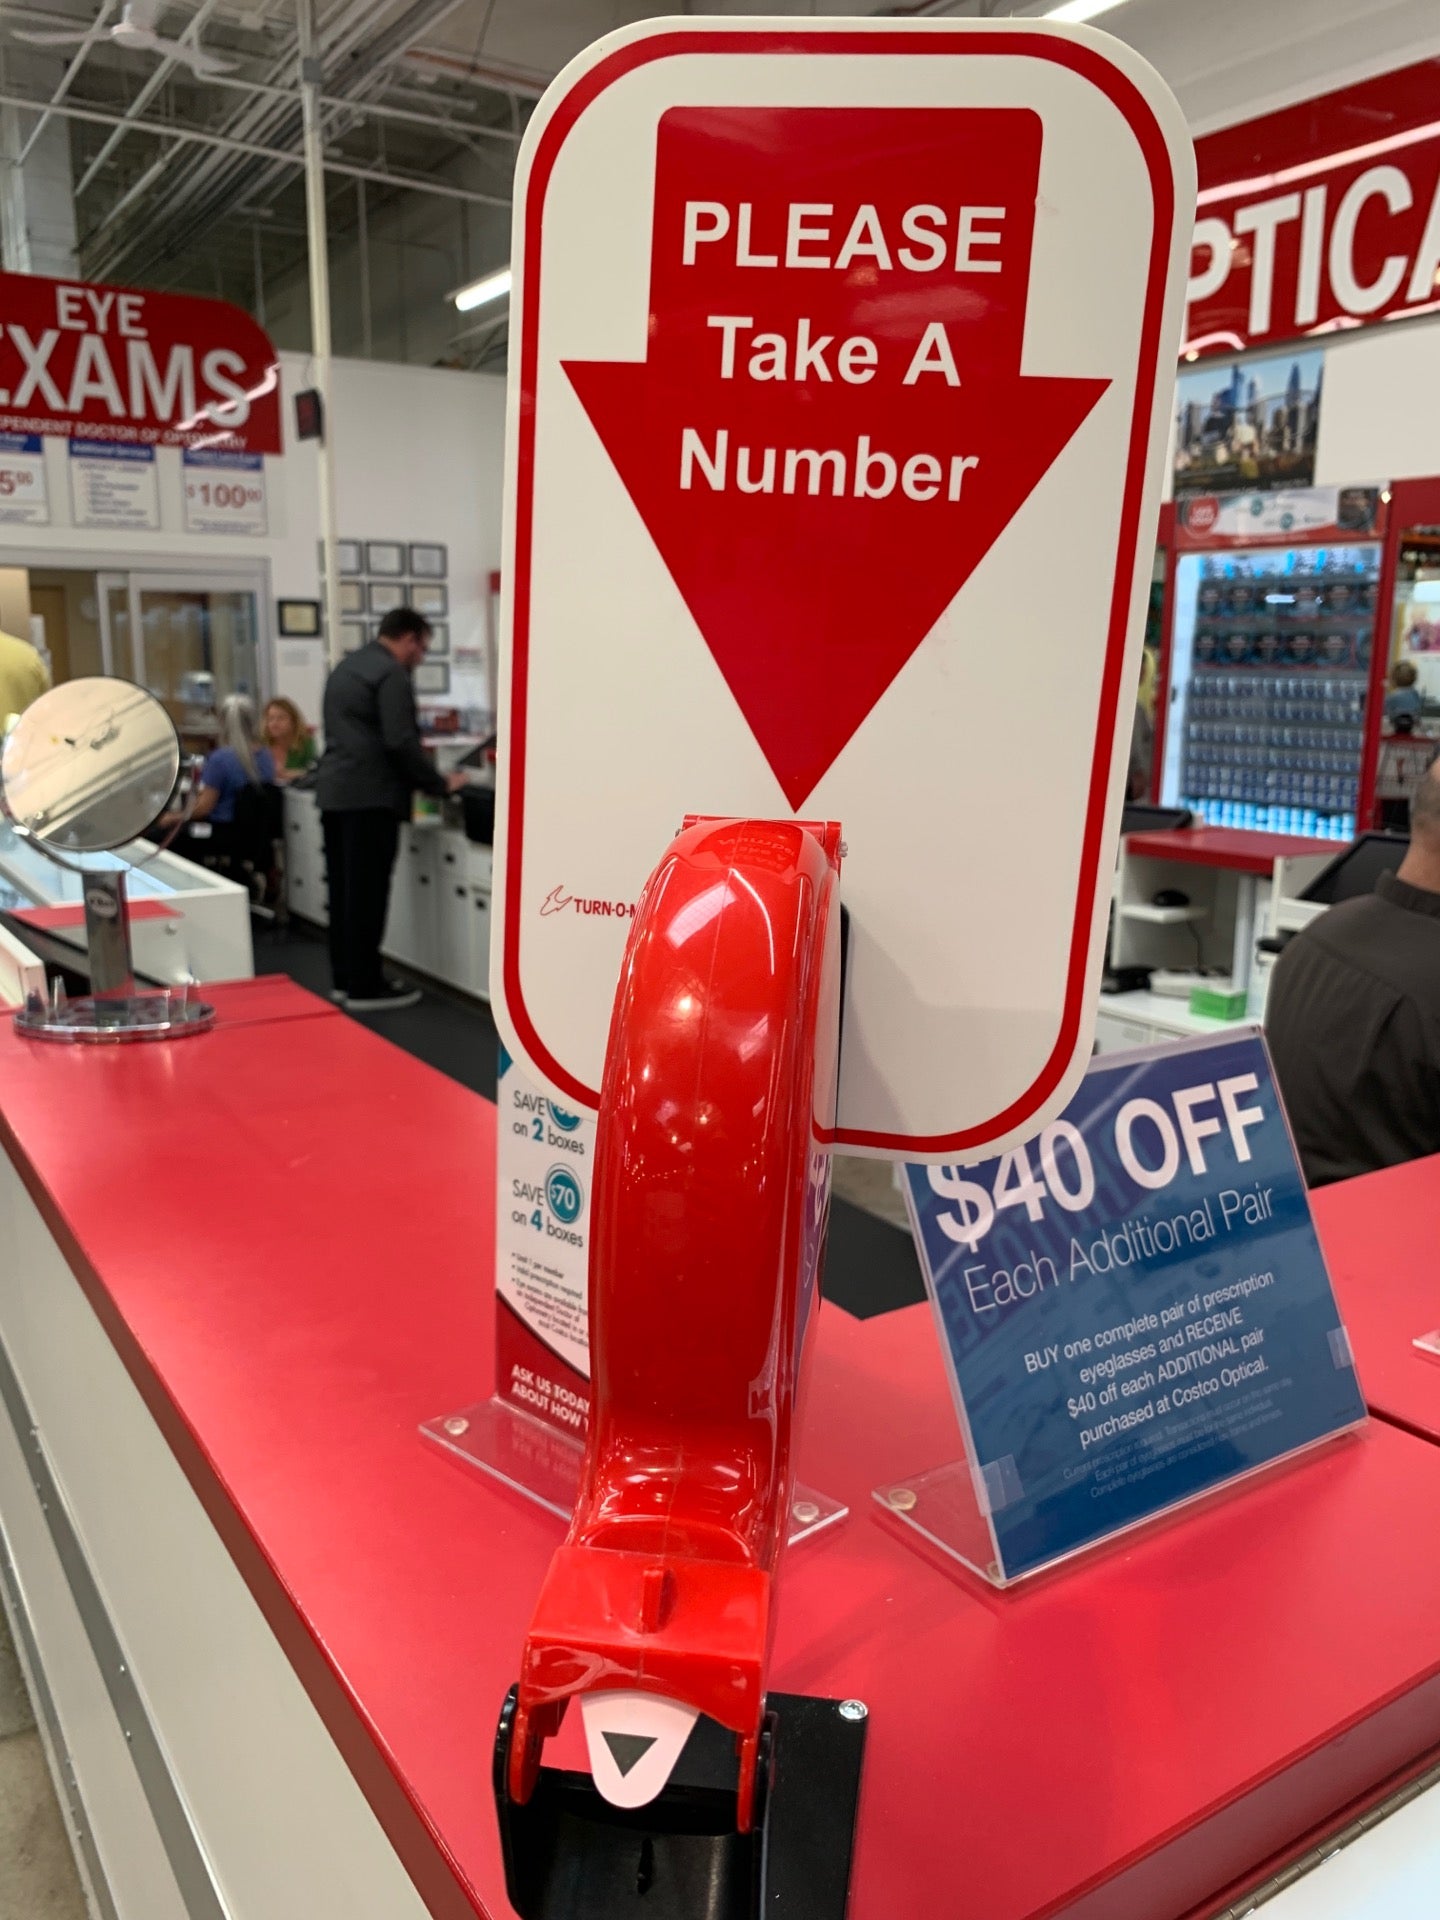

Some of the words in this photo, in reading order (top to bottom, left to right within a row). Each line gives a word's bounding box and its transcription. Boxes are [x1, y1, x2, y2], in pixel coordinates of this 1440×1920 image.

[682, 201, 1006, 274] PLEASE
[56, 285, 149, 338] EYE
[707, 315, 878, 383] Take
[902, 322, 961, 387] A
[75, 421, 138, 441] DOCTOR
[162, 428, 248, 447] OPTOTRY
[679, 428, 980, 502] Number
[513, 1090, 545, 1116] SAVE
[513, 1121, 528, 1137] on
[532, 1117, 544, 1142] 2
[547, 1124, 585, 1155] boxes
[512, 1178, 544, 1206] SAVE
[551, 1183, 576, 1211] $70
[927, 1118, 1095, 1253] $40
[1113, 1072, 1265, 1190] OFF
[512, 1210, 527, 1226] on
[530, 1208, 544, 1232] 4
[546, 1215, 584, 1248] boxes
[964, 1250, 1060, 1312] Each
[1069, 1198, 1216, 1281] Additional
[1219, 1182, 1273, 1231] Pair
[1024, 1344, 1059, 1373] BUY
[1063, 1337, 1092, 1359] one
[1094, 1313, 1159, 1348] complete
[1160, 1301, 1185, 1328] pair
[1187, 1293, 1201, 1313] of
[1202, 1271, 1275, 1312] prescription
[1079, 1343, 1157, 1384] eyeglasses
[1158, 1329, 1185, 1353] and
[1184, 1306, 1244, 1343] RECEIVE
[511, 1363, 535, 1386] ASK
[535, 1375, 552, 1394] US
[553, 1384, 590, 1414] TODAY
[511, 1381, 549, 1411] ABOUT
[550, 1401, 582, 1427] HOW
[1066, 1391, 1096, 1419] $40
[1098, 1382, 1119, 1405] off
[1120, 1370, 1155, 1397] each
[1157, 1336, 1240, 1383] ADDITIONAL
[1240, 1327, 1265, 1353] pair
[1079, 1400, 1155, 1450] purchased
[1156, 1394, 1171, 1415] at
[1171, 1377, 1220, 1407] Costco
[1220, 1355, 1270, 1387] Optical.
